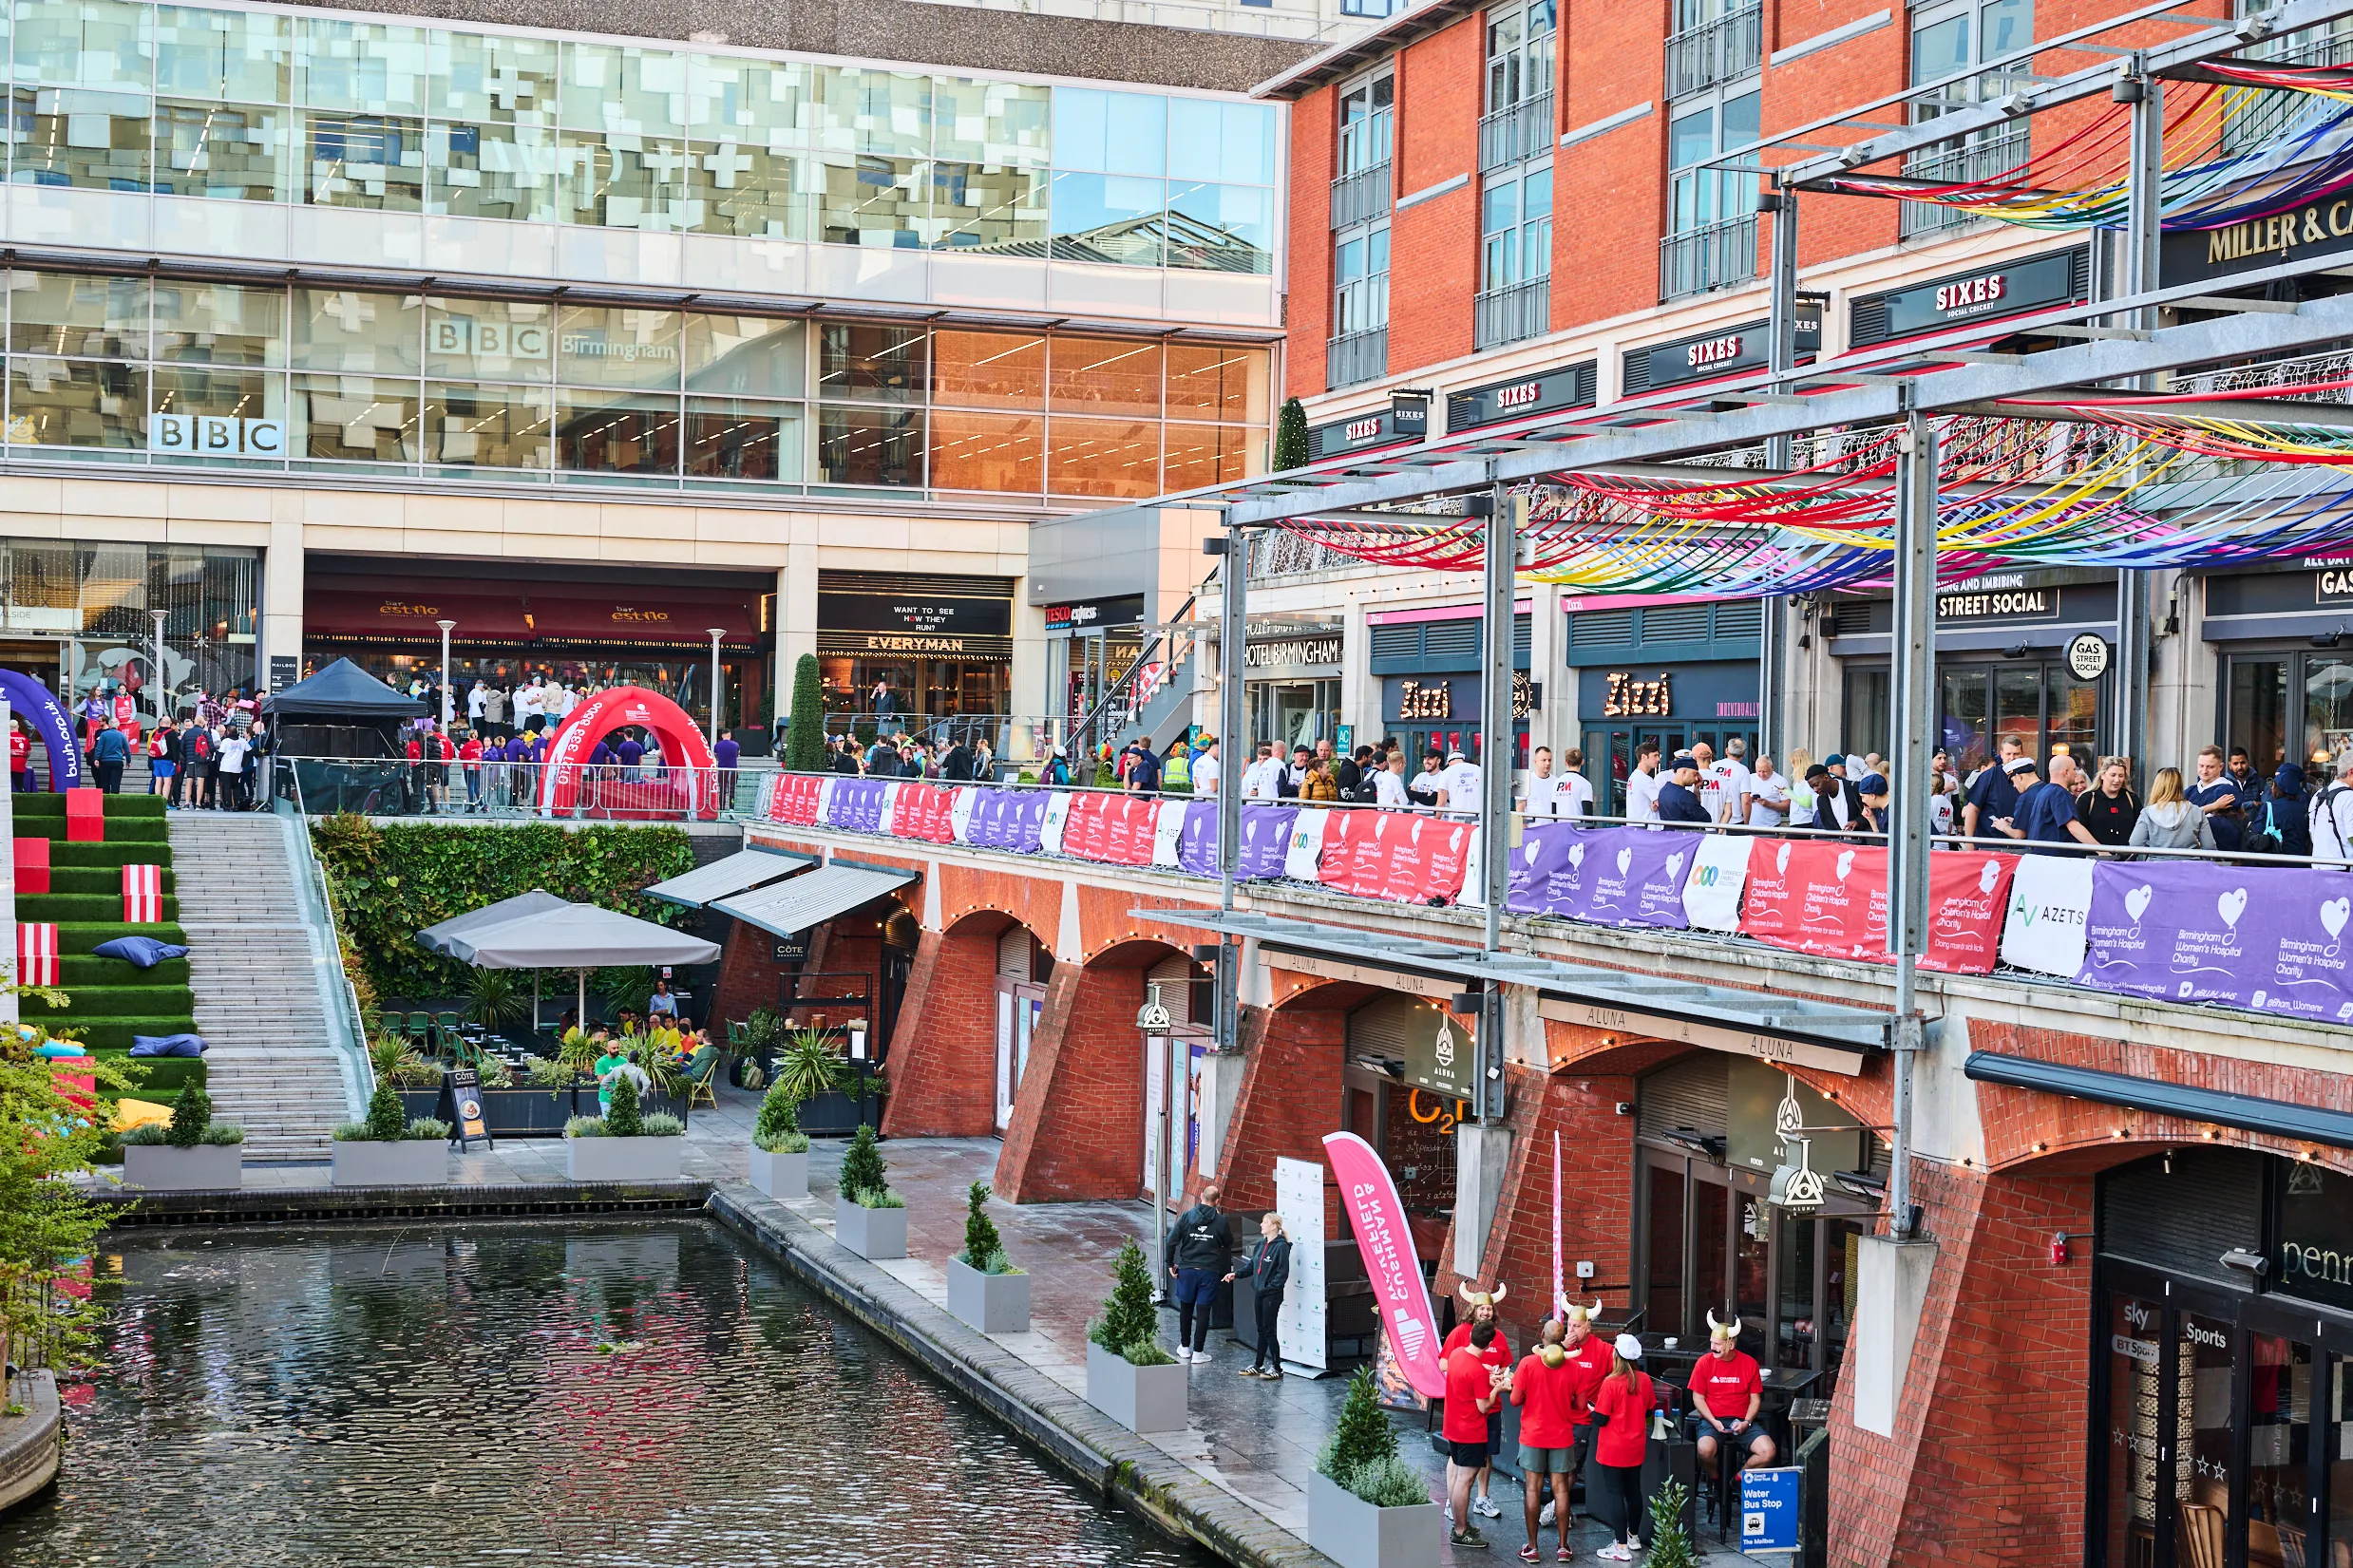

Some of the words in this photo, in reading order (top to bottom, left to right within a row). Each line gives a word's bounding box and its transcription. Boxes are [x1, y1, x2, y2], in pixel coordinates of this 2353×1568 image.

[2206, 210, 2298, 265] MILLER
[2303, 206, 2329, 244] &
[1935, 274, 2002, 312] SIXES
[1946, 305, 1968, 318] SOCIAL
[1968, 301, 1994, 315] CRICKET
[1794, 320, 1818, 331] XES
[434, 322, 545, 356] BBC
[560, 332, 675, 362] Birmingham
[1687, 335, 1738, 367] SIXES
[1696, 364, 1713, 373] SOCIAL
[1713, 359, 1733, 369] CRICKET
[1497, 382, 1538, 409] SIXES
[1395, 410, 1425, 420] SIXES
[157, 417, 282, 453] BBC
[1345, 418, 1378, 441] SIXES
[1960, 577, 1979, 592] AND
[1982, 574, 2023, 590] IMBIBING
[1566, 597, 1584, 612] Zizzi
[1939, 595, 1989, 617] STREET
[1992, 591, 2045, 614] SOCIAL
[611, 611, 669, 621] estilo
[1045, 606, 1072, 622] TESCO
[1071, 605, 1097, 625] express
[867, 636, 963, 652] EVERYMAN
[2076, 642, 2100, 654] GAS
[1244, 644, 1271, 667] HOTEL
[1274, 640, 1338, 666] BIRMINGHAM
[2076, 654, 2101, 663] STREET
[2076, 663, 2101, 671] SOCIAL
[1400, 680, 1451, 719] Zizzi
[1603, 671, 1669, 717] Zizzi
[568, 728, 586, 752] 333
[580, 701, 603, 727] 8506
[45, 698, 78, 779] bwh.org.uk
[1338, 729, 1350, 743] AC
[1808, 881, 1836, 894] Birmingham
[1804, 902, 1822, 916] Charity
[1829, 897, 1850, 907] Hospital
[1936, 916, 1962, 931] Charity
[2041, 906, 2084, 925] AZETS
[2091, 925, 2128, 937] Birmingham
[2177, 929, 2221, 943] Birmingham
[777, 945, 804, 954] CÔTE
[1934, 938, 1950, 951] Doing
[2118, 938, 2146, 951] Hospital
[2174, 941, 2211, 954] Women's
[2210, 945, 2242, 957] Hospital
[2279, 937, 2324, 954] Birmingham
[1291, 956, 1317, 973] ALUNA
[2172, 952, 2199, 967] Charity
[2277, 951, 2313, 965] Women's
[2313, 955, 2346, 970] Hospital
[2275, 963, 2303, 978] Charity
[1395, 974, 1424, 992] ALUNA
[2266, 998, 2324, 1013] @Bham_Womens
[1586, 1007, 1626, 1029] ALUNA
[1750, 1035, 1793, 1060] ALUNA
[1434, 1067, 1455, 1079] ALUNA
[1750, 1157, 1764, 1167] FOOD
[2124, 1301, 2150, 1331] sky
[2186, 1322, 2227, 1350] Sports
[2116, 1338, 2131, 1352] BT
[1744, 1489, 1770, 1498] Water
[1744, 1500, 1760, 1509] Bus
[1761, 1500, 1783, 1509] Stop
